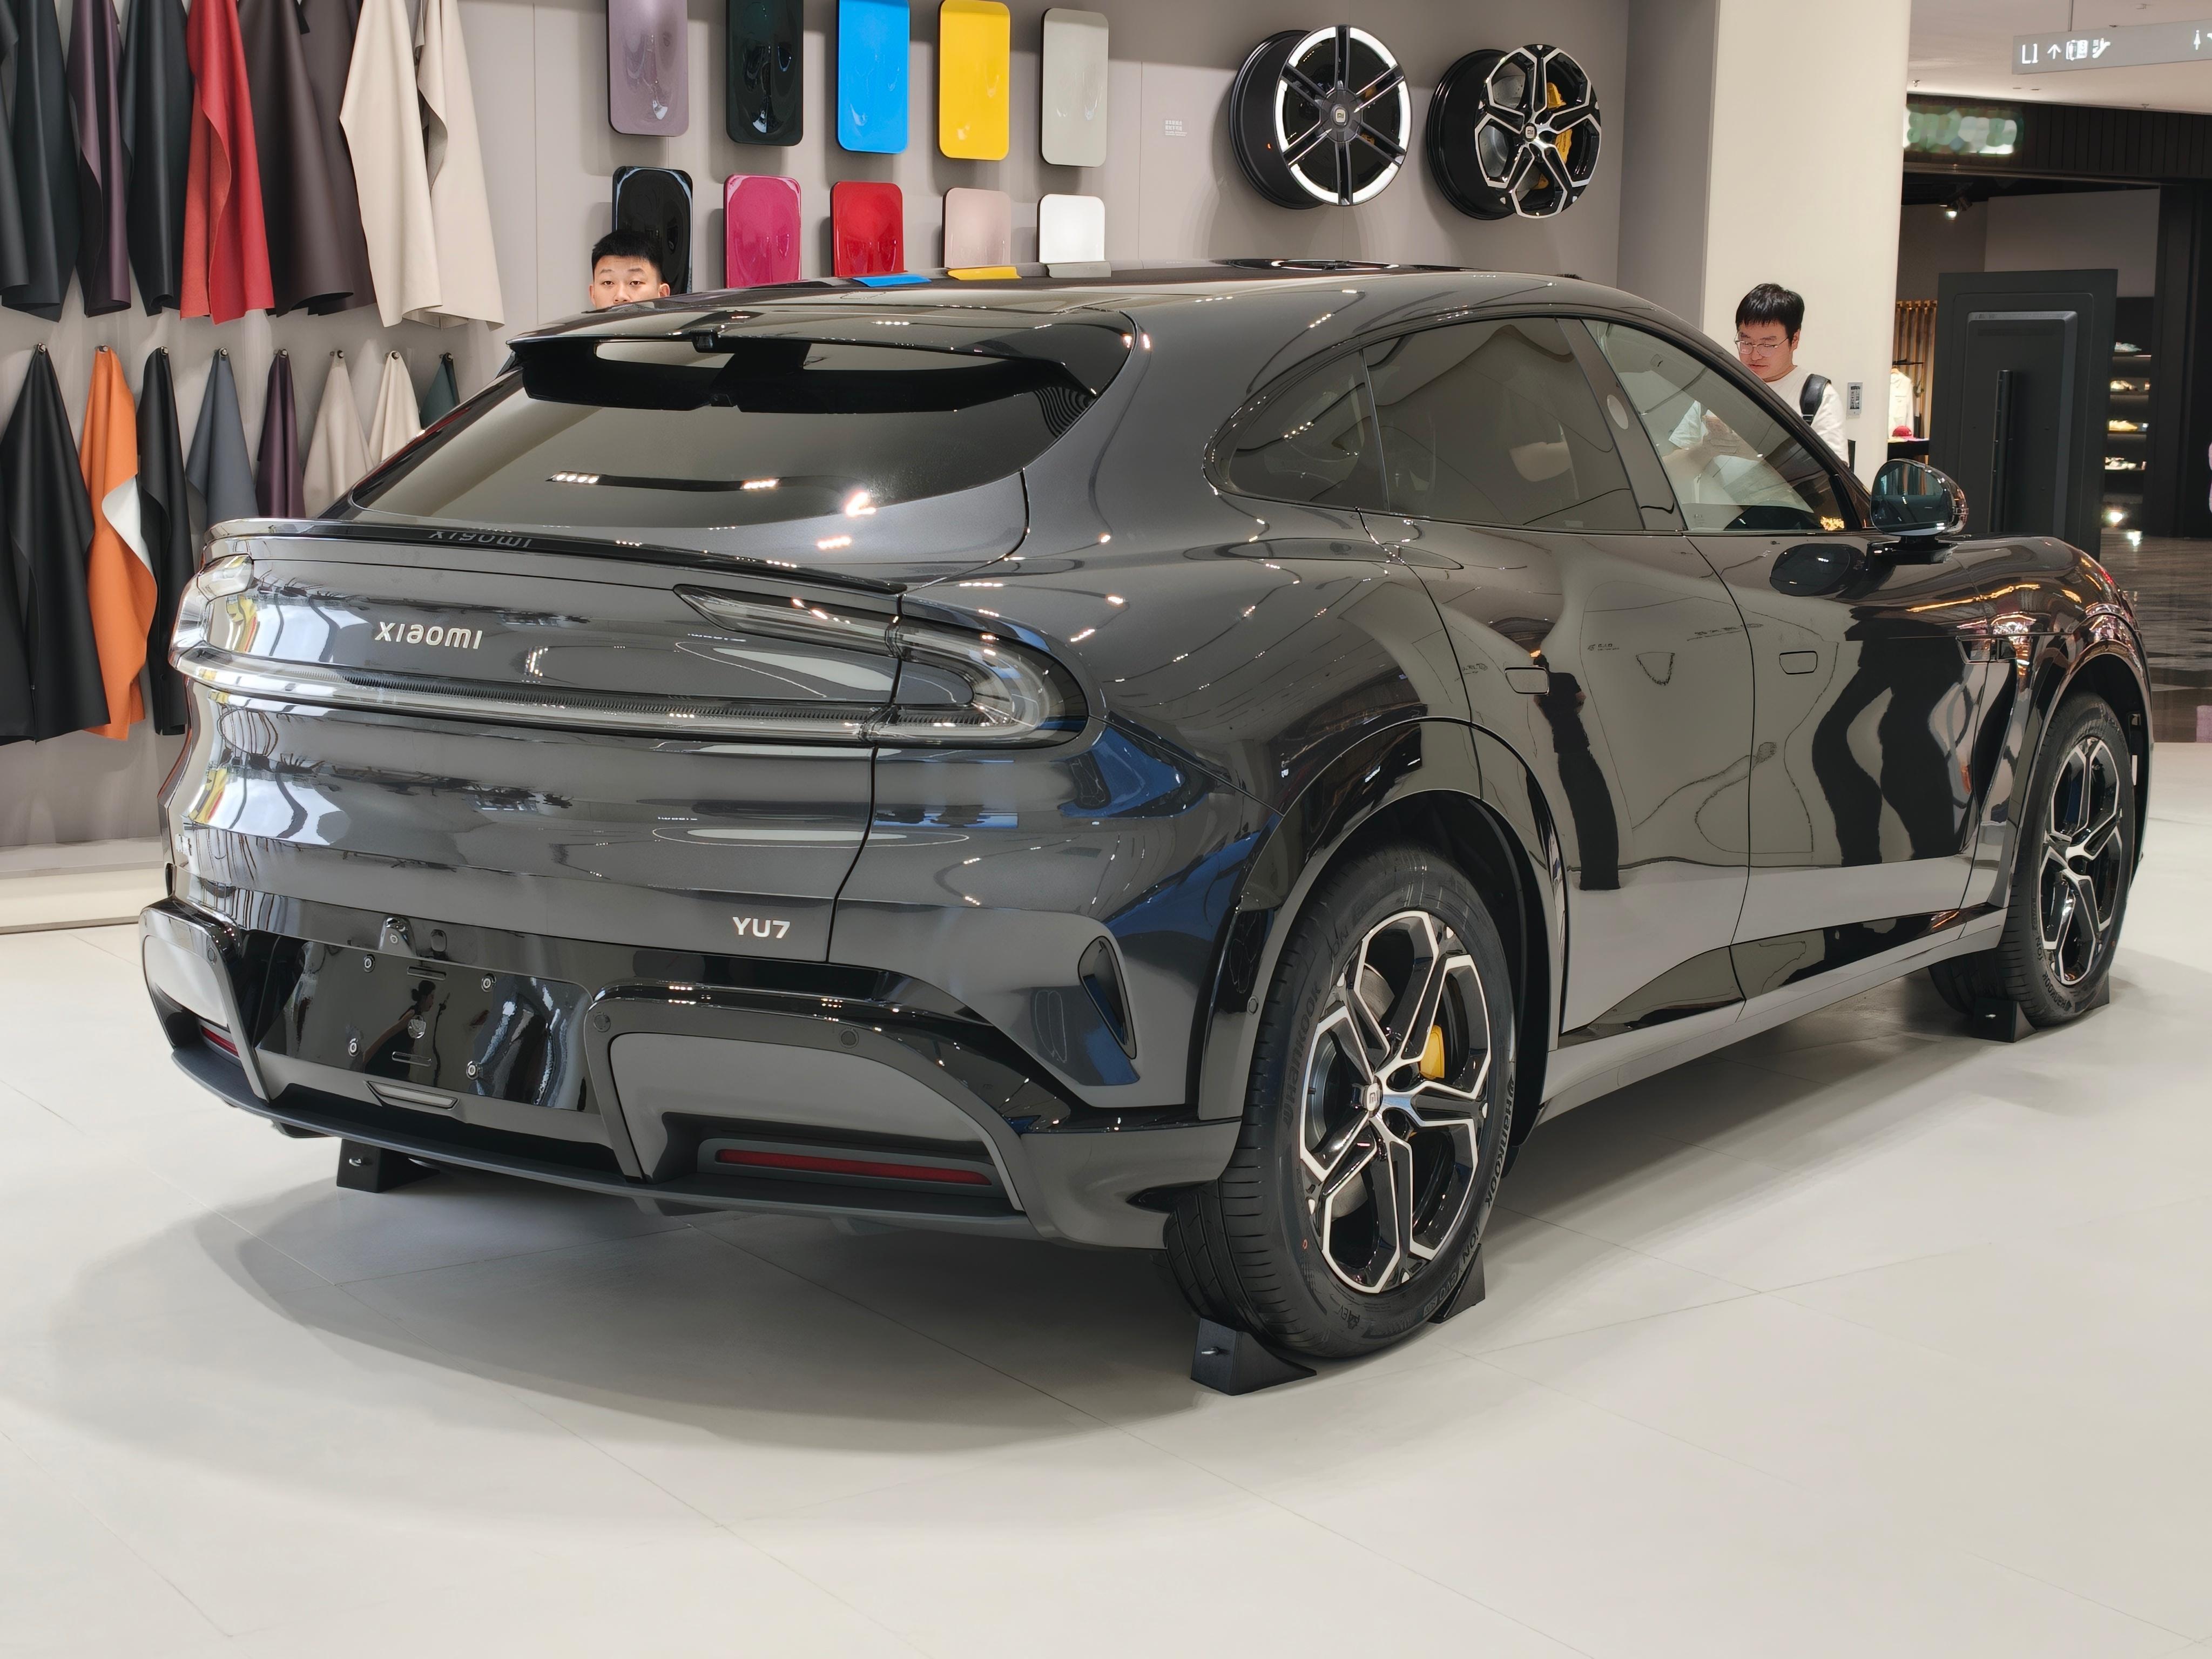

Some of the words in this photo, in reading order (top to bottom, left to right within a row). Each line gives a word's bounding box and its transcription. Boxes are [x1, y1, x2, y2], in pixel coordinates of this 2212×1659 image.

[2021, 44, 2039, 64] L1
[375, 622, 482, 649] xiaomi
[732, 916, 791, 939] YU7
